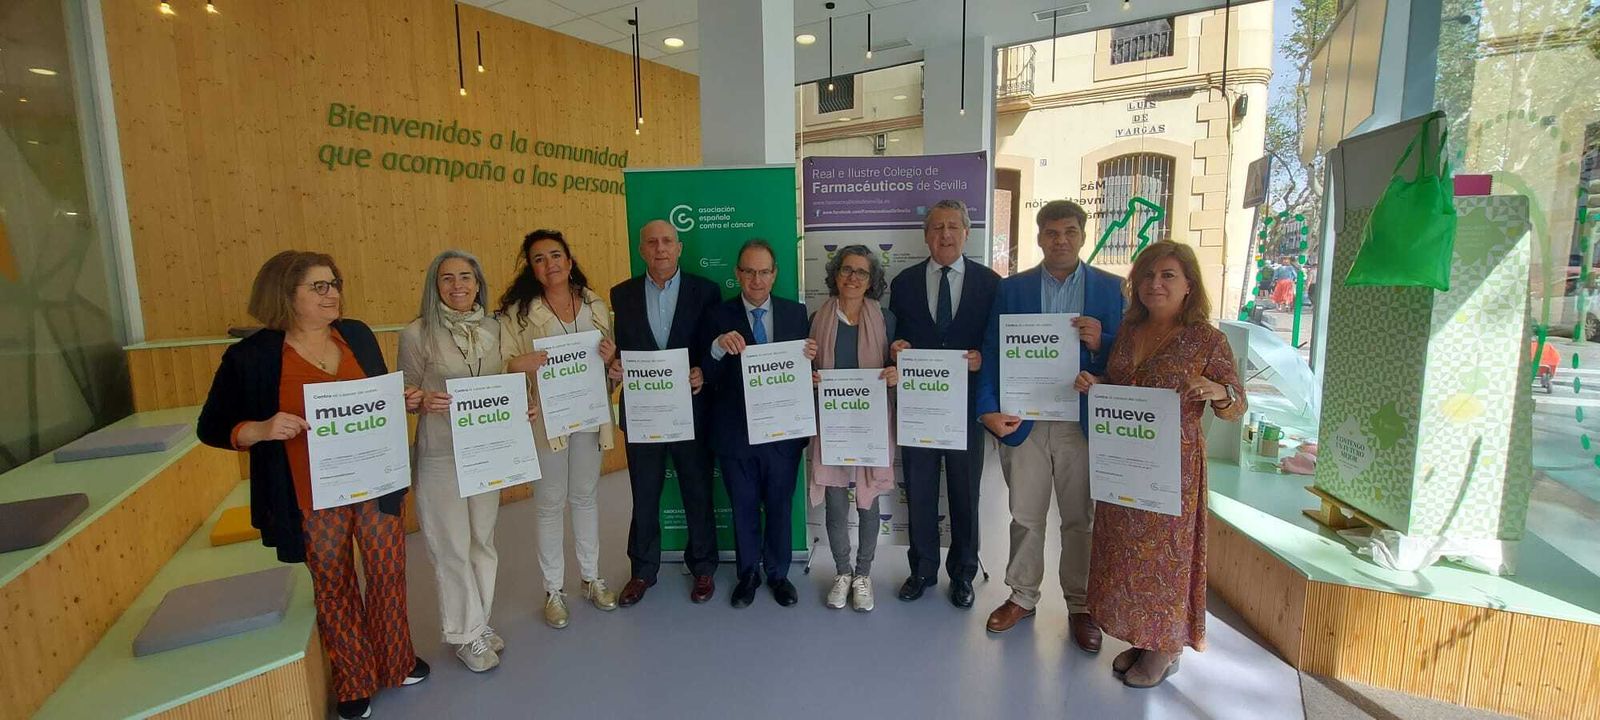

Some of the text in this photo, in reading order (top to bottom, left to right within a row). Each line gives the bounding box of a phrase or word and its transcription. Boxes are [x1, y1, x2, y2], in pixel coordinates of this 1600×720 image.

[1127, 100, 1157, 110] LUIS
[1132, 114, 1149, 123] DE
[327, 102, 629, 169] Bienvenidos a la comunidad
[1116, 125, 1166, 137] VARGAS
[318, 143, 626, 196] que acompaña a las persona
[812, 166, 939, 179] Real e Ilustre Colegio de
[812, 179, 968, 194] Farmacéuticos de Sevilla
[699, 214, 731, 222] española
[699, 222, 722, 230] contra
[1006, 332, 1060, 344] mueve
[1006, 346, 1059, 359] el culo
[542, 362, 588, 380] el culo
[627, 368, 673, 378] mueve
[748, 360, 795, 374] mueve
[902, 366, 950, 378] mueve
[628, 380, 674, 391] el culo
[750, 372, 796, 387] el culo
[902, 380, 949, 392] el culo
[824, 387, 870, 397] mueve
[456, 395, 510, 411] mueve
[824, 398, 870, 410] el culo
[316, 400, 386, 420] mueve
[1095, 406, 1156, 423] mueve
[458, 408, 510, 428] el culo
[316, 415, 387, 437] el culo
[1095, 421, 1156, 440] el culo
